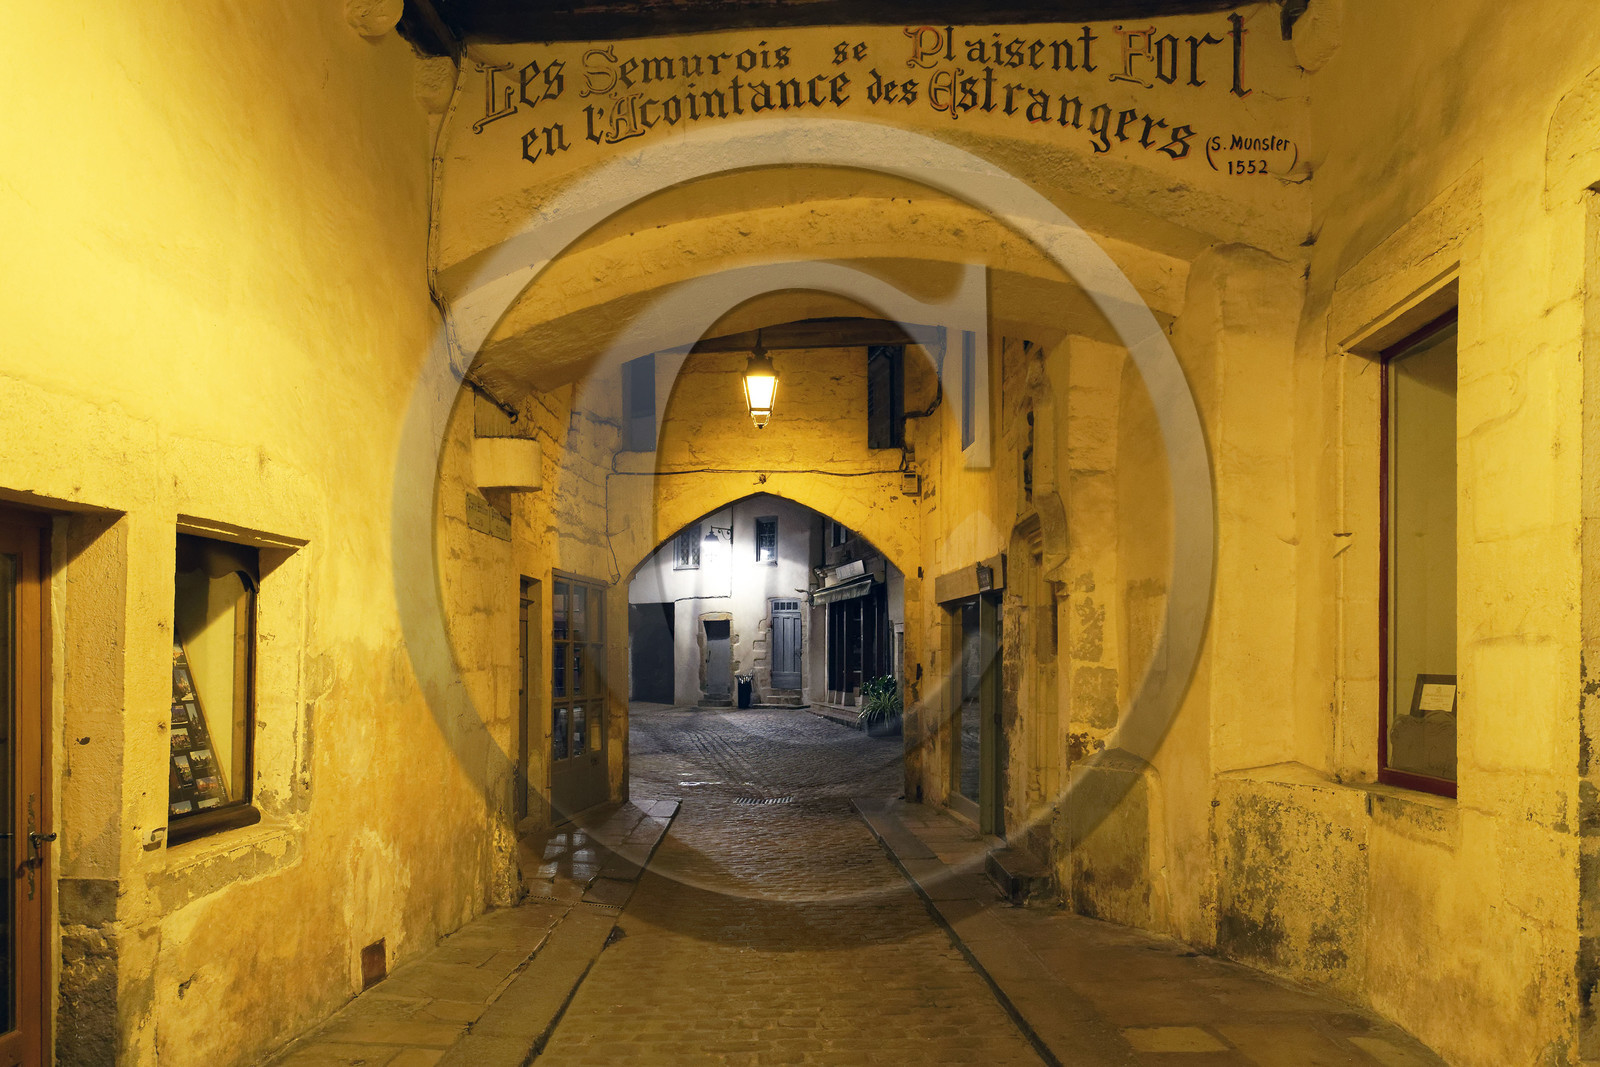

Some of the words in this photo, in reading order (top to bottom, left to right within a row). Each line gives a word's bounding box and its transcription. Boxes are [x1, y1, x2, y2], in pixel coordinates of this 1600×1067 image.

[472, 56, 567, 135] Les
[578, 40, 792, 98] Semurois
[831, 38, 869, 68] se
[903, 25, 1099, 73] Plaisent
[1109, 12, 1252, 98] Fort
[520, 120, 571, 164] en
[582, 70, 852, 145] l'Acointance
[866, 69, 919, 106] des
[927, 66, 1198, 161] Estrangers
